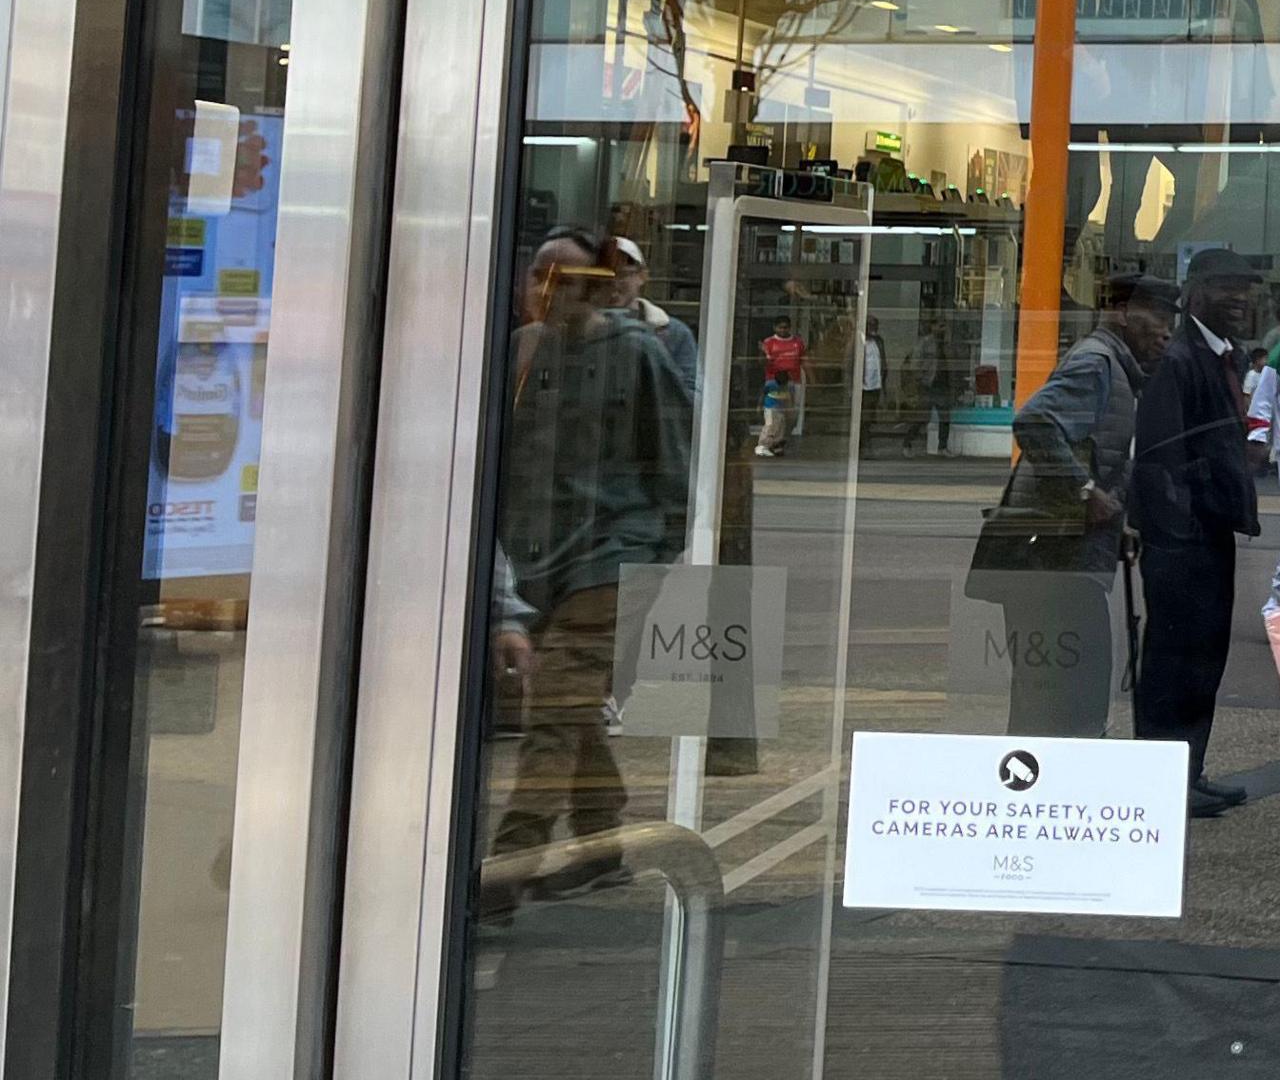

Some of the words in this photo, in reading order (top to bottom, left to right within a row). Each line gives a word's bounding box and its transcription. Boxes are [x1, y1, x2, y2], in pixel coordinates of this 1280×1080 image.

[651, 623, 748, 662] M&S
[984, 629, 1081, 668] M&S
[888, 798, 931, 815] FOR
[939, 800, 998, 817] YOUR
[1005, 803, 1093, 823] SAFETY,
[1099, 806, 1146, 822] OUR
[871, 820, 978, 838] CAMERAS
[985, 823, 1028, 839] ARE
[1035, 825, 1121, 842] ALWAYS
[1128, 827, 1161, 844] ON
[993, 855, 1035, 872] M&S
